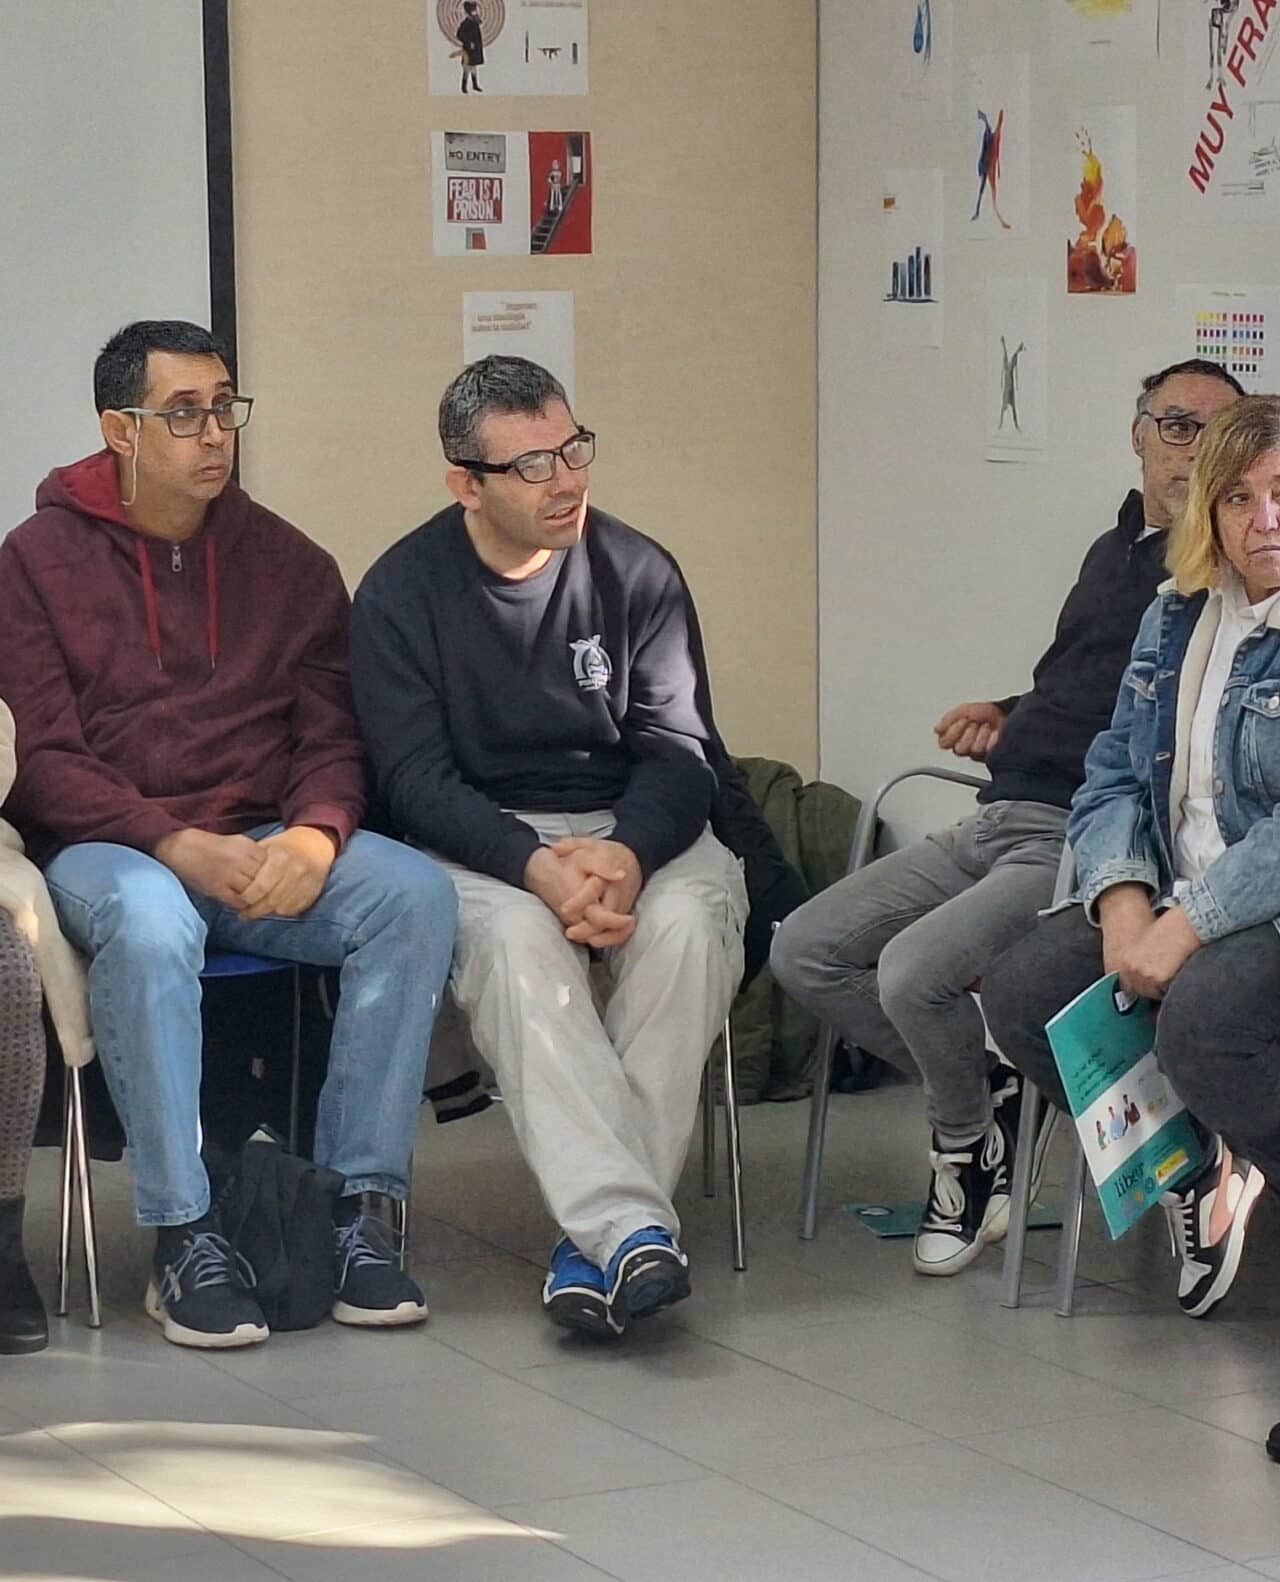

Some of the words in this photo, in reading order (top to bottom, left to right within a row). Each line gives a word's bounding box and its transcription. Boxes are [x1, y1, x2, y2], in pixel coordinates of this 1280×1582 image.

[1188, 82, 1234, 194] MUY
[466, 151, 502, 163] ENTRY
[449, 179, 479, 202] FEAR
[480, 180, 491, 200] IS
[493, 180, 501, 200] A
